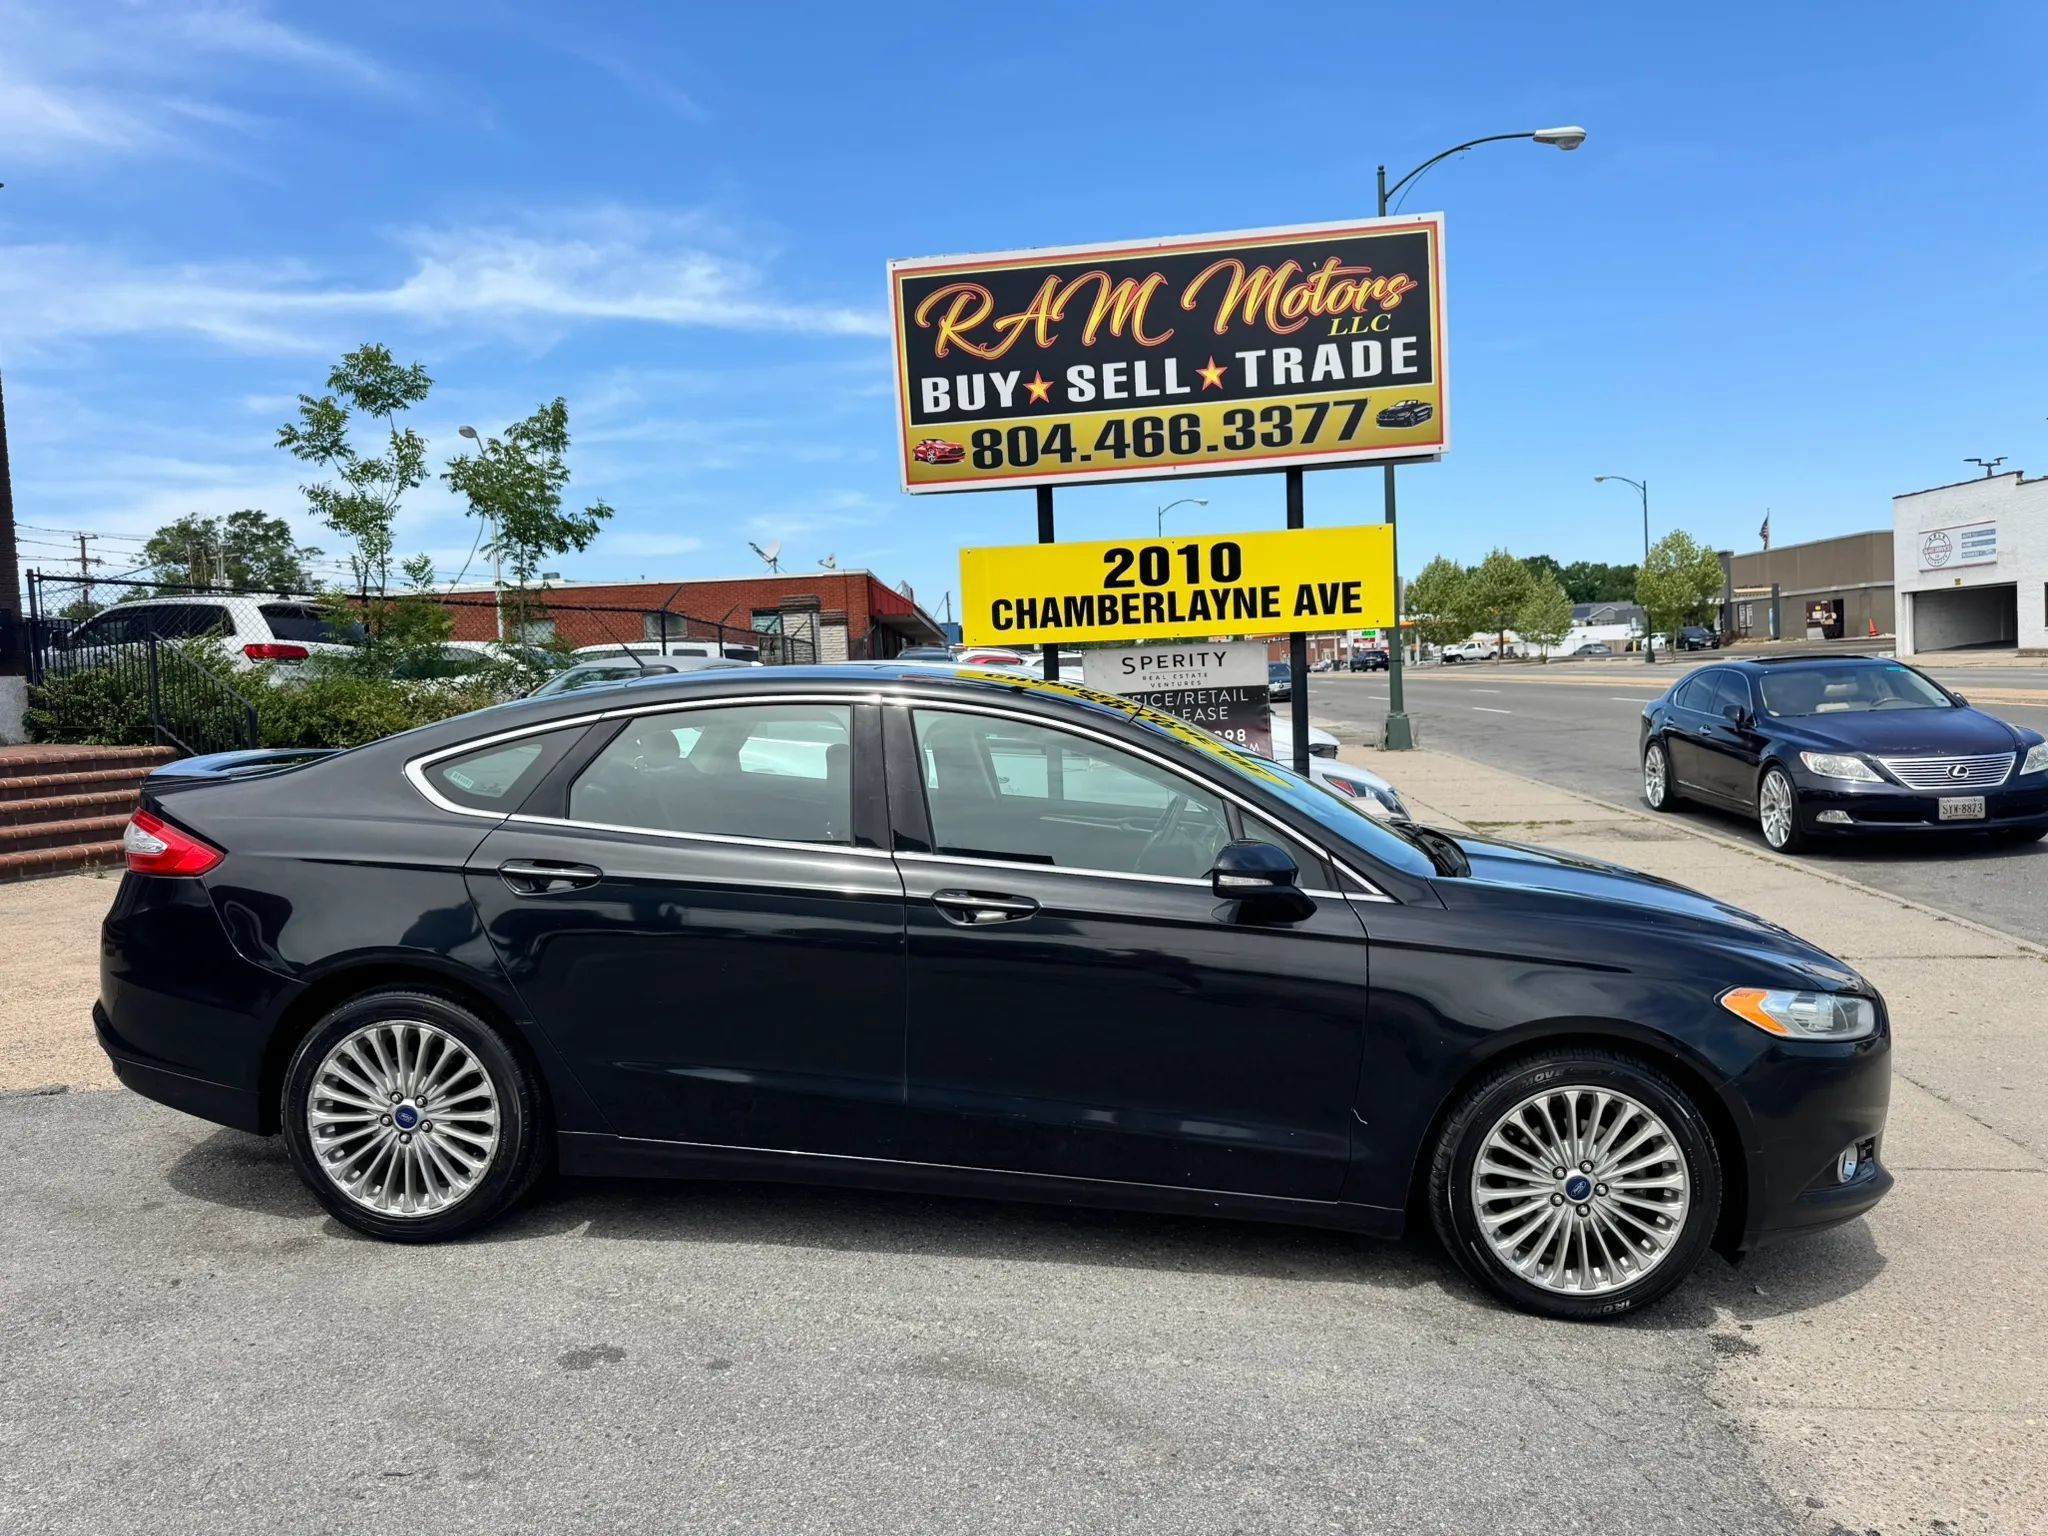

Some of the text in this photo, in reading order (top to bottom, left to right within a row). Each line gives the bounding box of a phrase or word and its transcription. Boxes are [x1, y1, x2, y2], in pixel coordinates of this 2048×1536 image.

[1180, 255, 1418, 336] Motors
[1326, 311, 1393, 337] LLC
[920, 335, 1418, 414] BUY SELL TRADE
[970, 397, 1370, 470] 804.466.3377
[1103, 541, 1242, 589] 2010
[991, 580, 1363, 632] CHAMBERLAYNE AVE
[1121, 651, 1227, 675] SPERITY
[1142, 671, 1209, 681] REAL ESTATE
[1150, 680, 1202, 688] VENTURES
[1124, 688, 1249, 708] FICE/RETAIL
[1171, 706, 1229, 722] EASE
